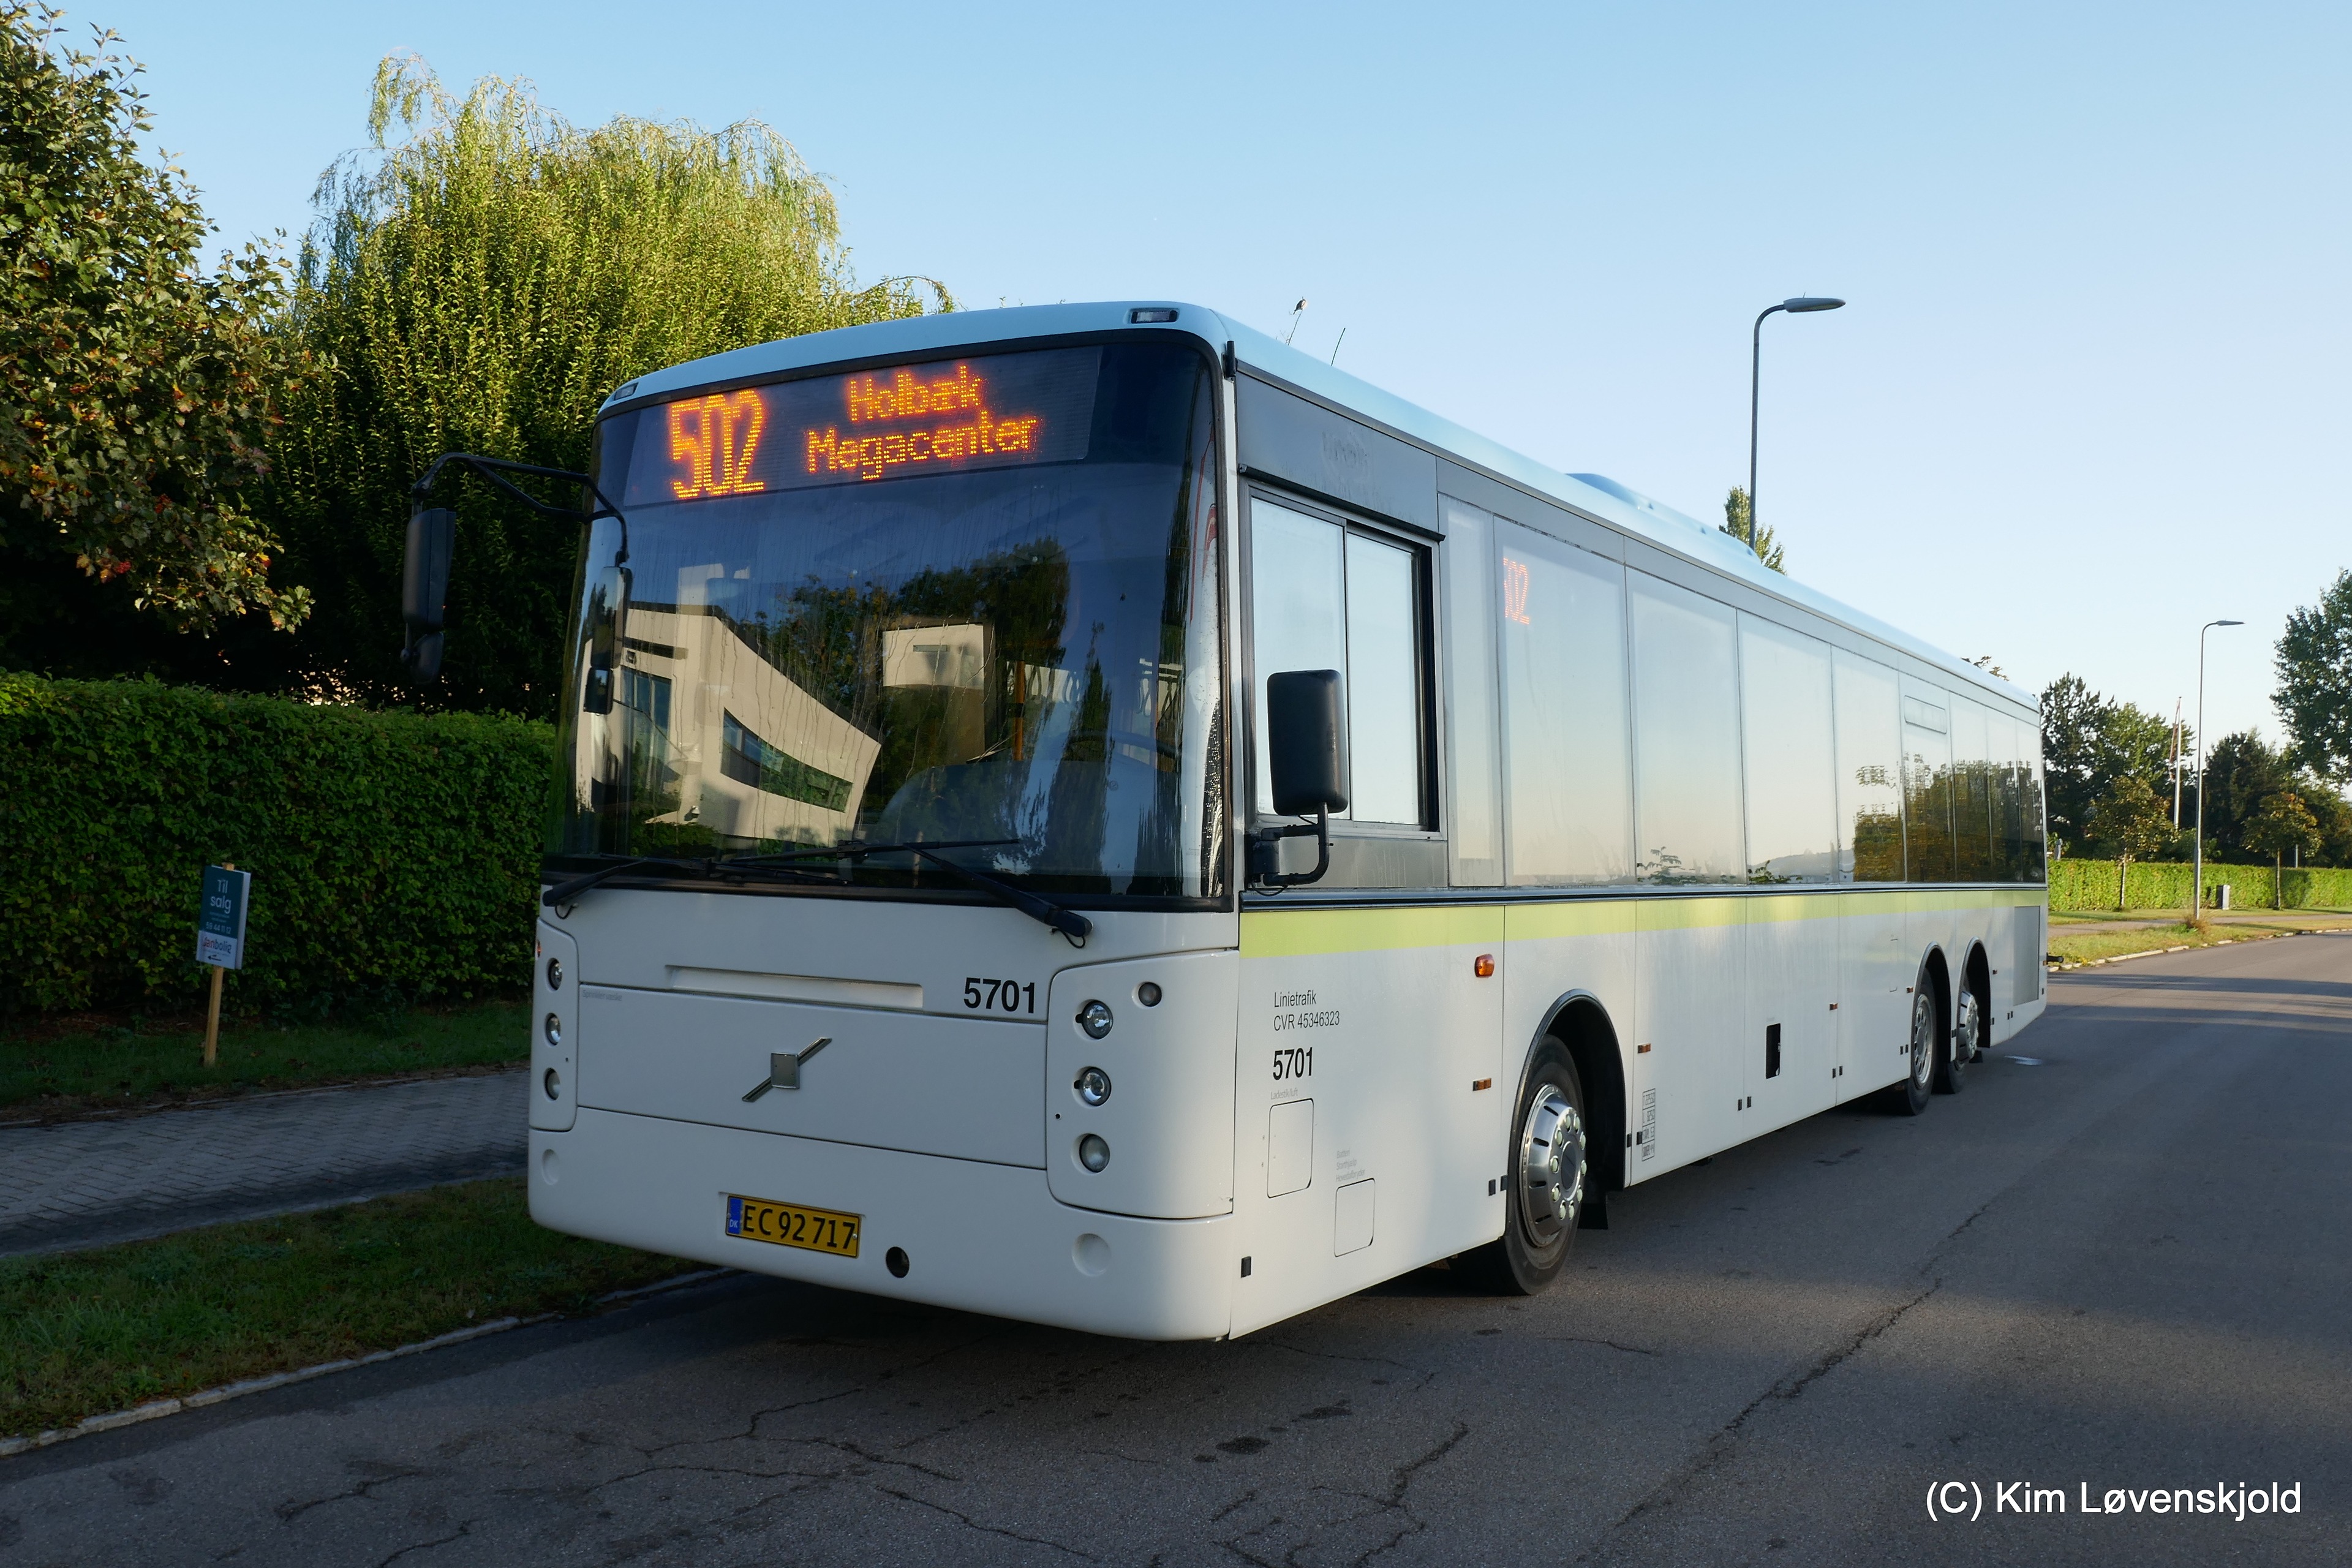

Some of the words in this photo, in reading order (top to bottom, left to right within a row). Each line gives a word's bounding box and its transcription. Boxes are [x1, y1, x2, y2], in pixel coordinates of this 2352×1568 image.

[849, 365, 982, 421] Holbæk
[671, 389, 765, 499] 502
[807, 410, 1038, 480] Megacenter
[217, 879, 228, 894] Til
[210, 895, 232, 914] salg
[963, 977, 1035, 1014] 5701
[1273, 990, 1317, 1008] Linietrafik
[1273, 1014, 1295, 1031] CVR
[1297, 1011, 1340, 1028] 45346323
[1273, 1047, 1313, 1080] 5701
[729, 1219, 738, 1229] DK
[743, 1205, 774, 1235] EC
[778, 1211, 806, 1242] 92
[812, 1216, 856, 1250] 717
